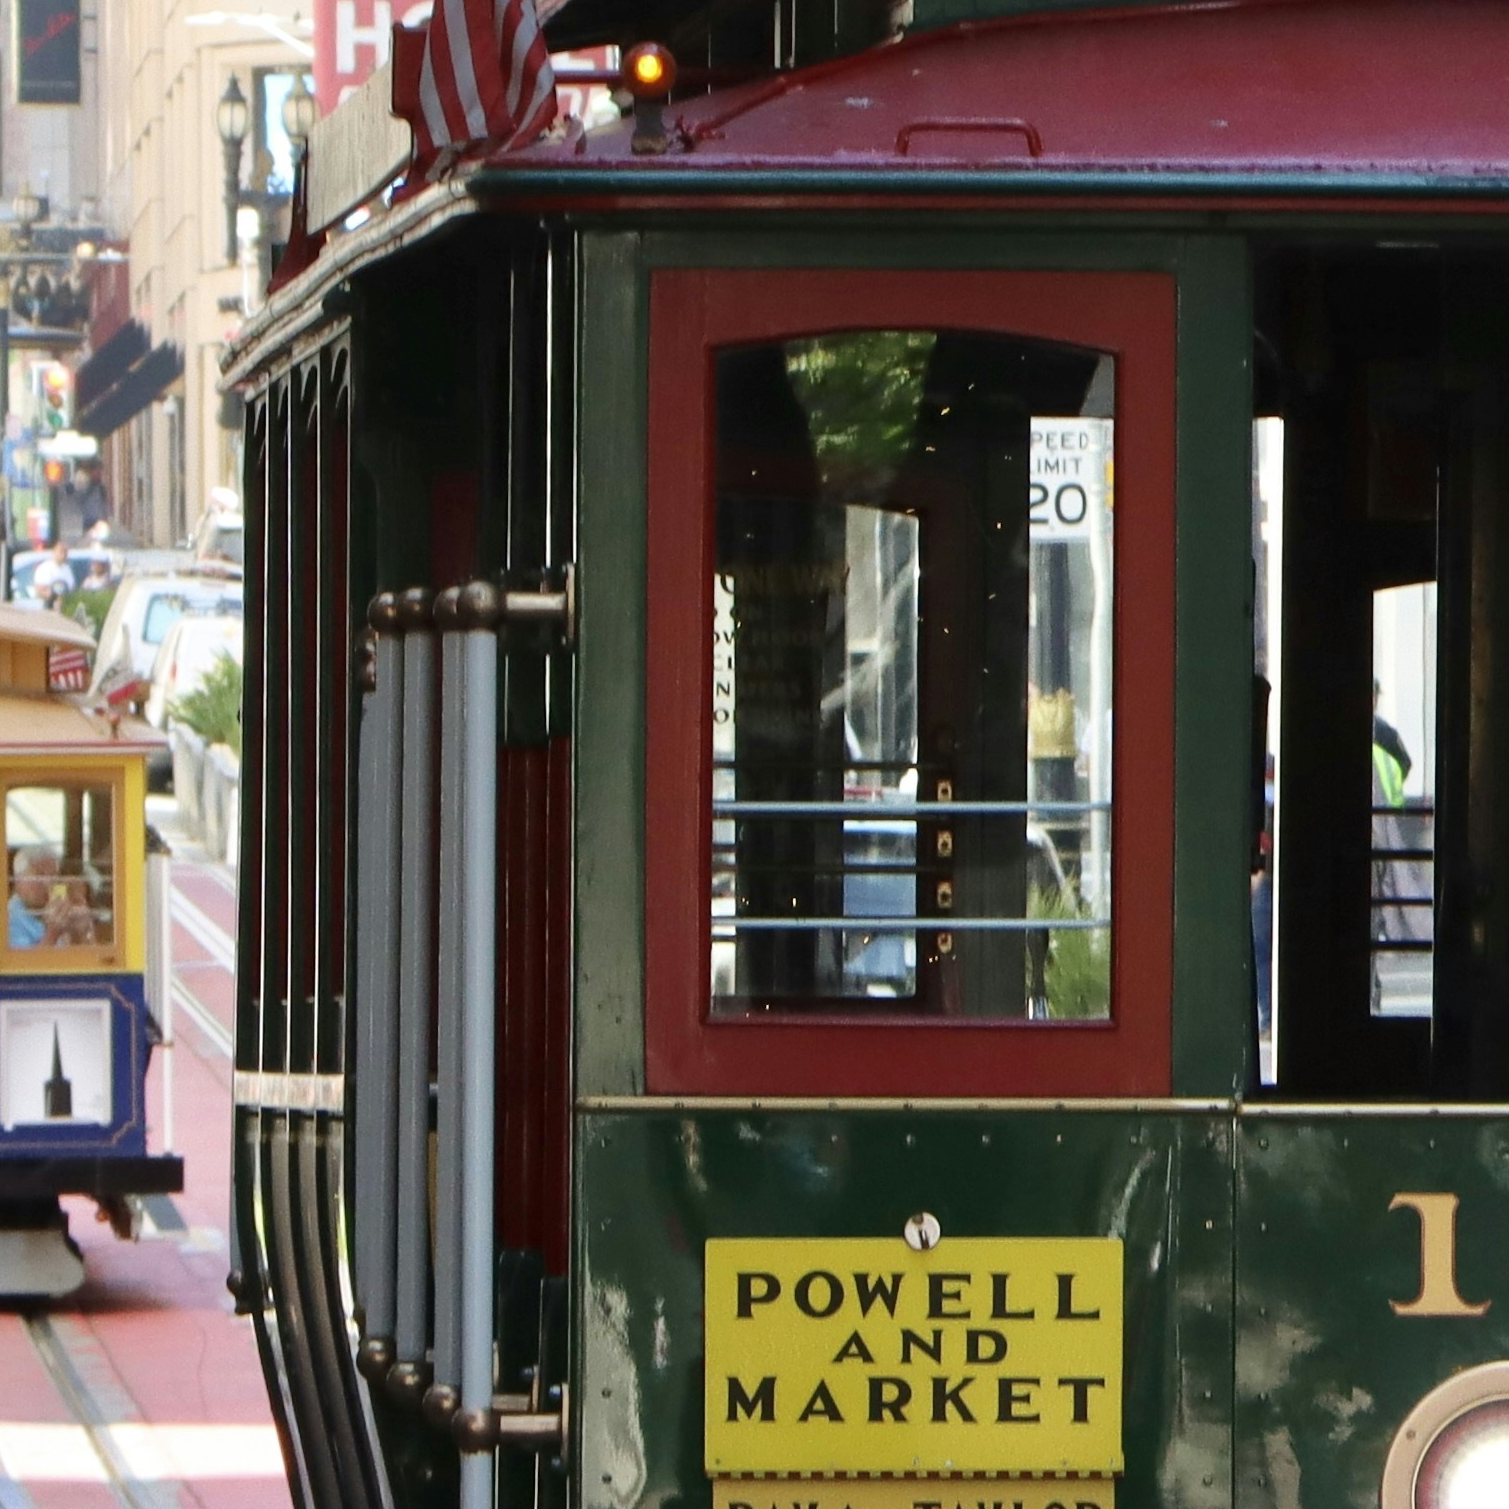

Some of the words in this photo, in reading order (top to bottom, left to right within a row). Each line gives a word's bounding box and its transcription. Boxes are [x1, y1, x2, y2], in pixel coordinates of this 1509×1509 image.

[1030, 432, 1090, 451] PEED
[1032, 457, 1083, 474] IMIT
[1030, 482, 1088, 524] 20
[735, 1272, 1100, 1321] POWELL
[833, 1328, 1008, 1365] AND
[724, 1377, 1106, 1425] MARKET
